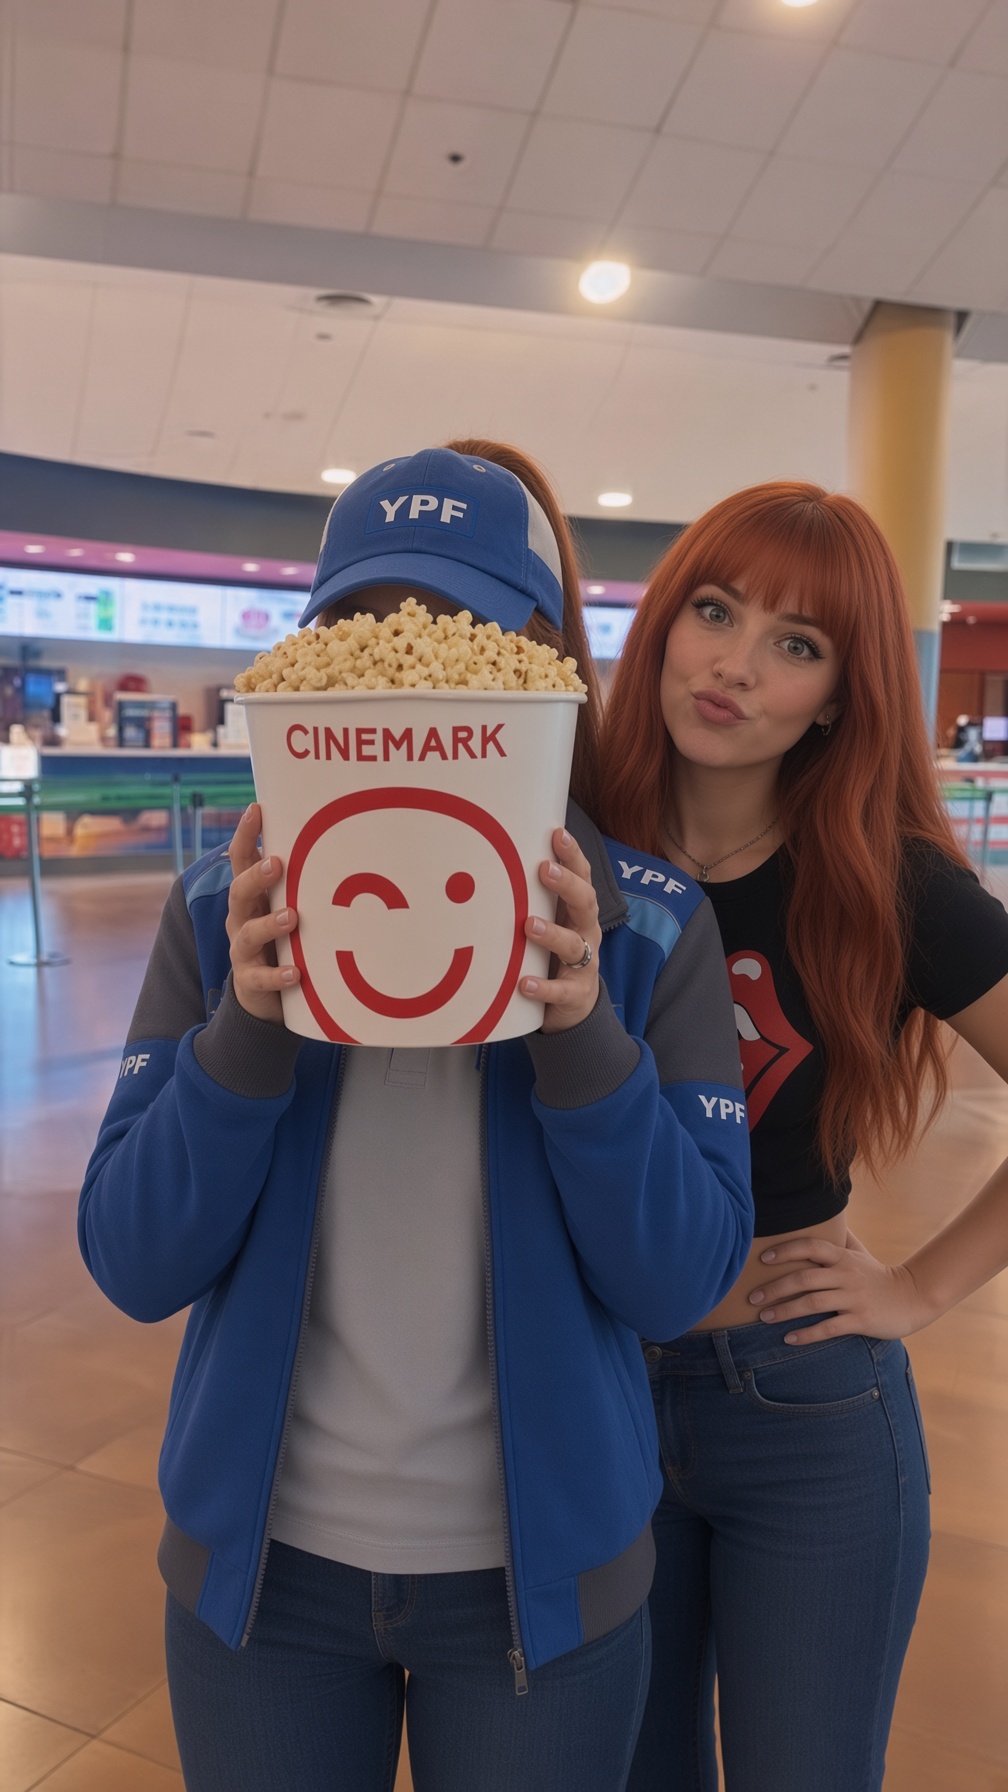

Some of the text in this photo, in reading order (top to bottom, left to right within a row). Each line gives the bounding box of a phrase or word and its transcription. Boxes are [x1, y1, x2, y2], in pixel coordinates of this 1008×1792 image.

[380, 494, 467, 524] YPF
[286, 723, 507, 762] CINEMARK
[618, 860, 687, 894] YPF
[698, 1094, 745, 1124] YPF
